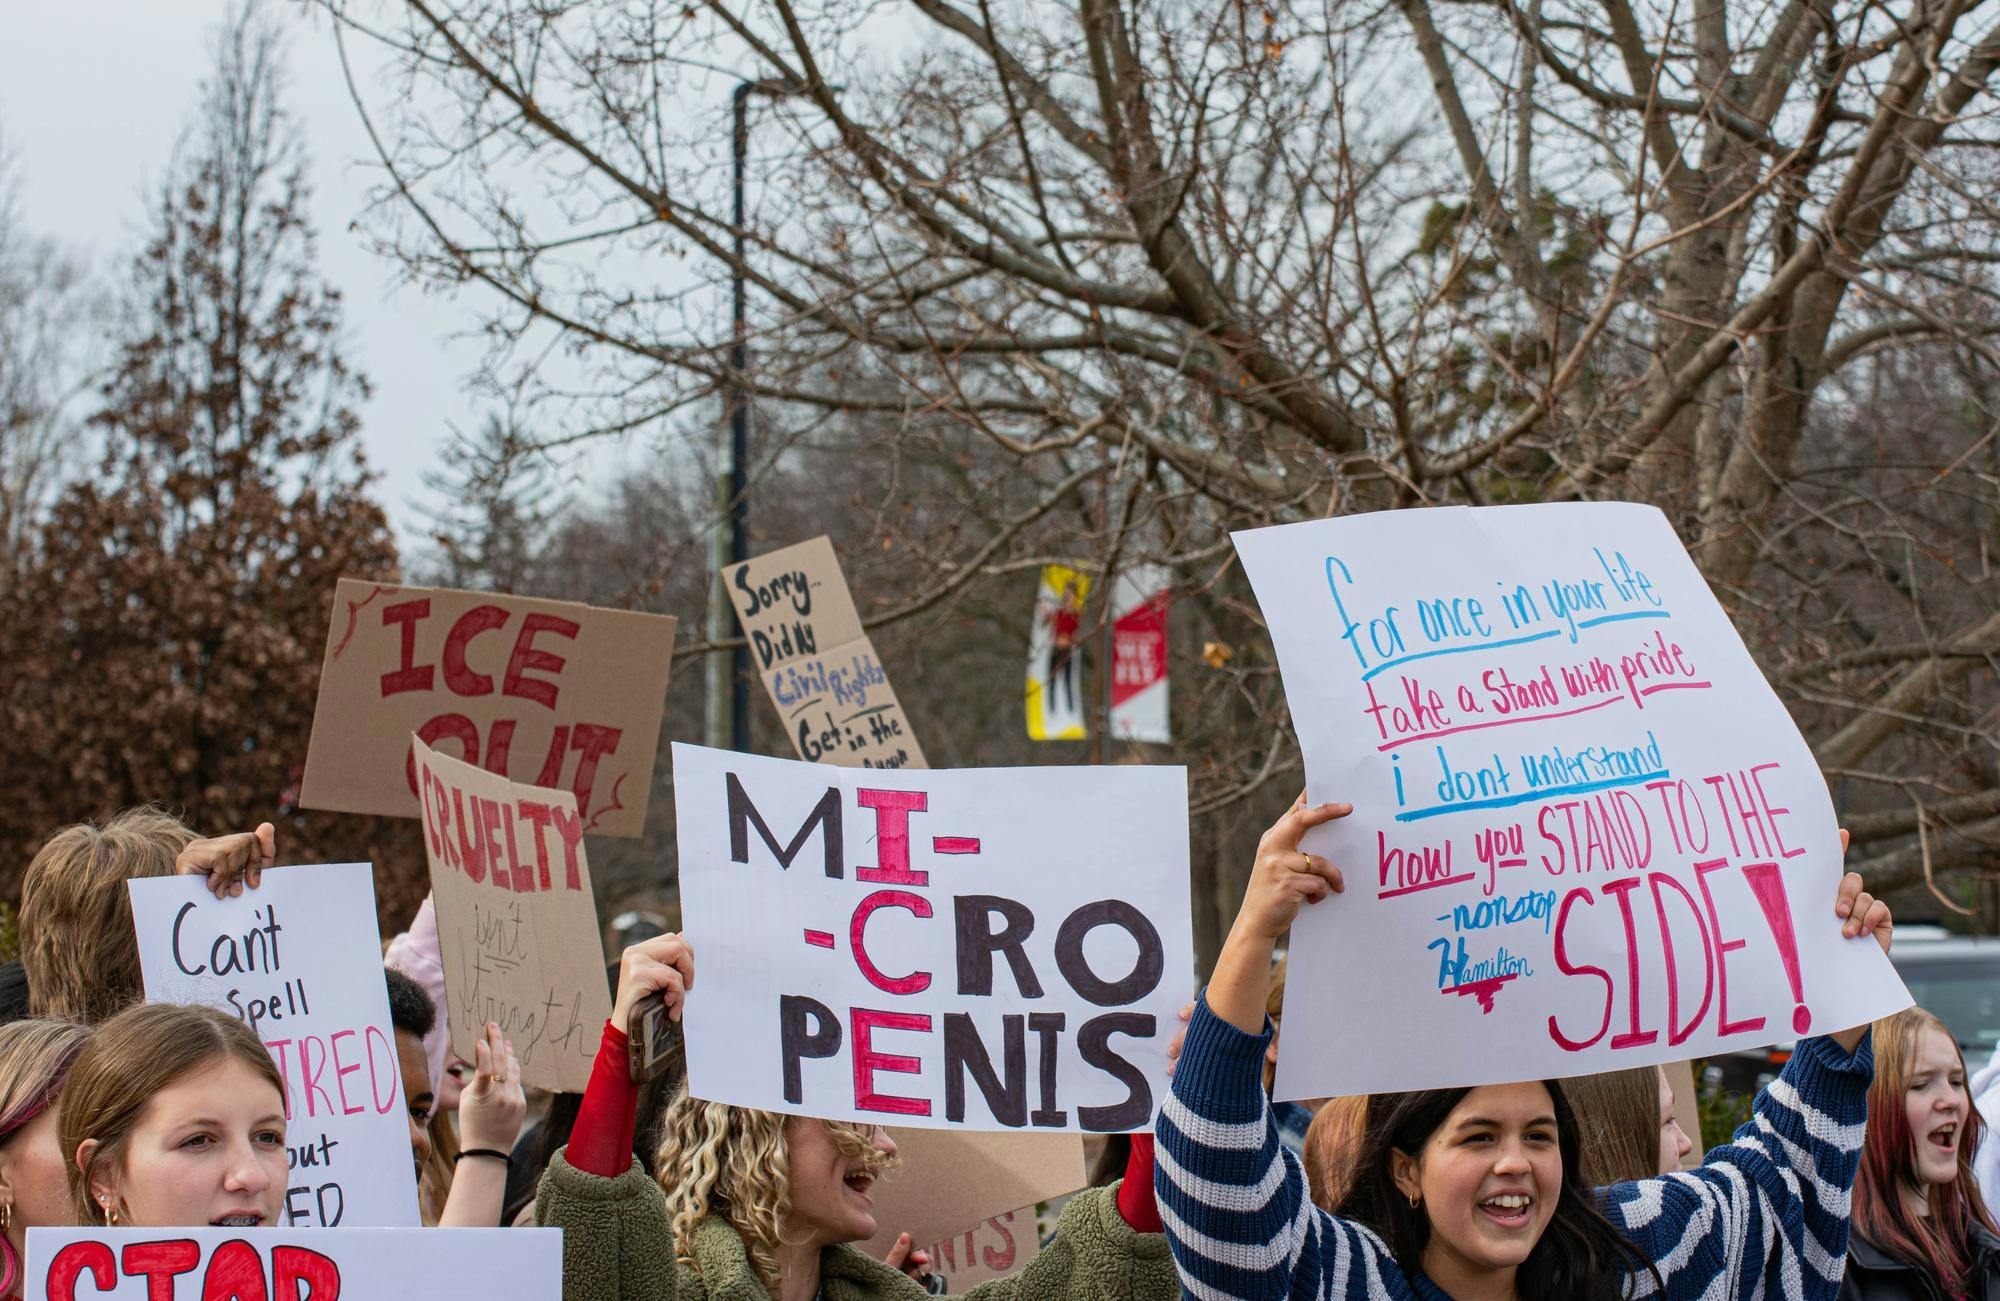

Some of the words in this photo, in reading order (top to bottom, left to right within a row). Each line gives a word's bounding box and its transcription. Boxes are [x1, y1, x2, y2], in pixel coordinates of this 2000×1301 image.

[380, 598, 580, 711] ICE
[752, 623, 793, 671] Did
[1326, 557, 1405, 668] for
[1417, 598, 1491, 642] once
[1497, 582, 1540, 628] in
[1543, 579, 1606, 643] your
[1593, 547, 1662, 606] life
[774, 662, 828, 707] Civil
[1364, 676, 1451, 739] take
[1458, 685, 1483, 712] a
[1620, 631, 1694, 709] pride
[406, 713, 623, 819] OUT
[799, 712, 841, 763] Get
[845, 727, 867, 751] in
[868, 714, 902, 745] the
[1392, 753, 1404, 806] i
[1437, 745, 1510, 801] dont
[1521, 731, 1662, 787] understand
[423, 762, 583, 893] CRUELTY
[1377, 830, 1451, 887] how
[1475, 824, 1524, 895] you
[1538, 791, 1651, 875] STAND
[1646, 779, 1709, 854] TO
[1703, 763, 1805, 858] THE
[172, 902, 282, 976] Can't
[1427, 937, 1533, 988] Hamilton
[1548, 857, 1811, 1052] SIDE!
[265, 1026, 397, 1121] TRED
[780, 994, 1157, 1132] PENIS
[285, 1183, 344, 1227] ED
